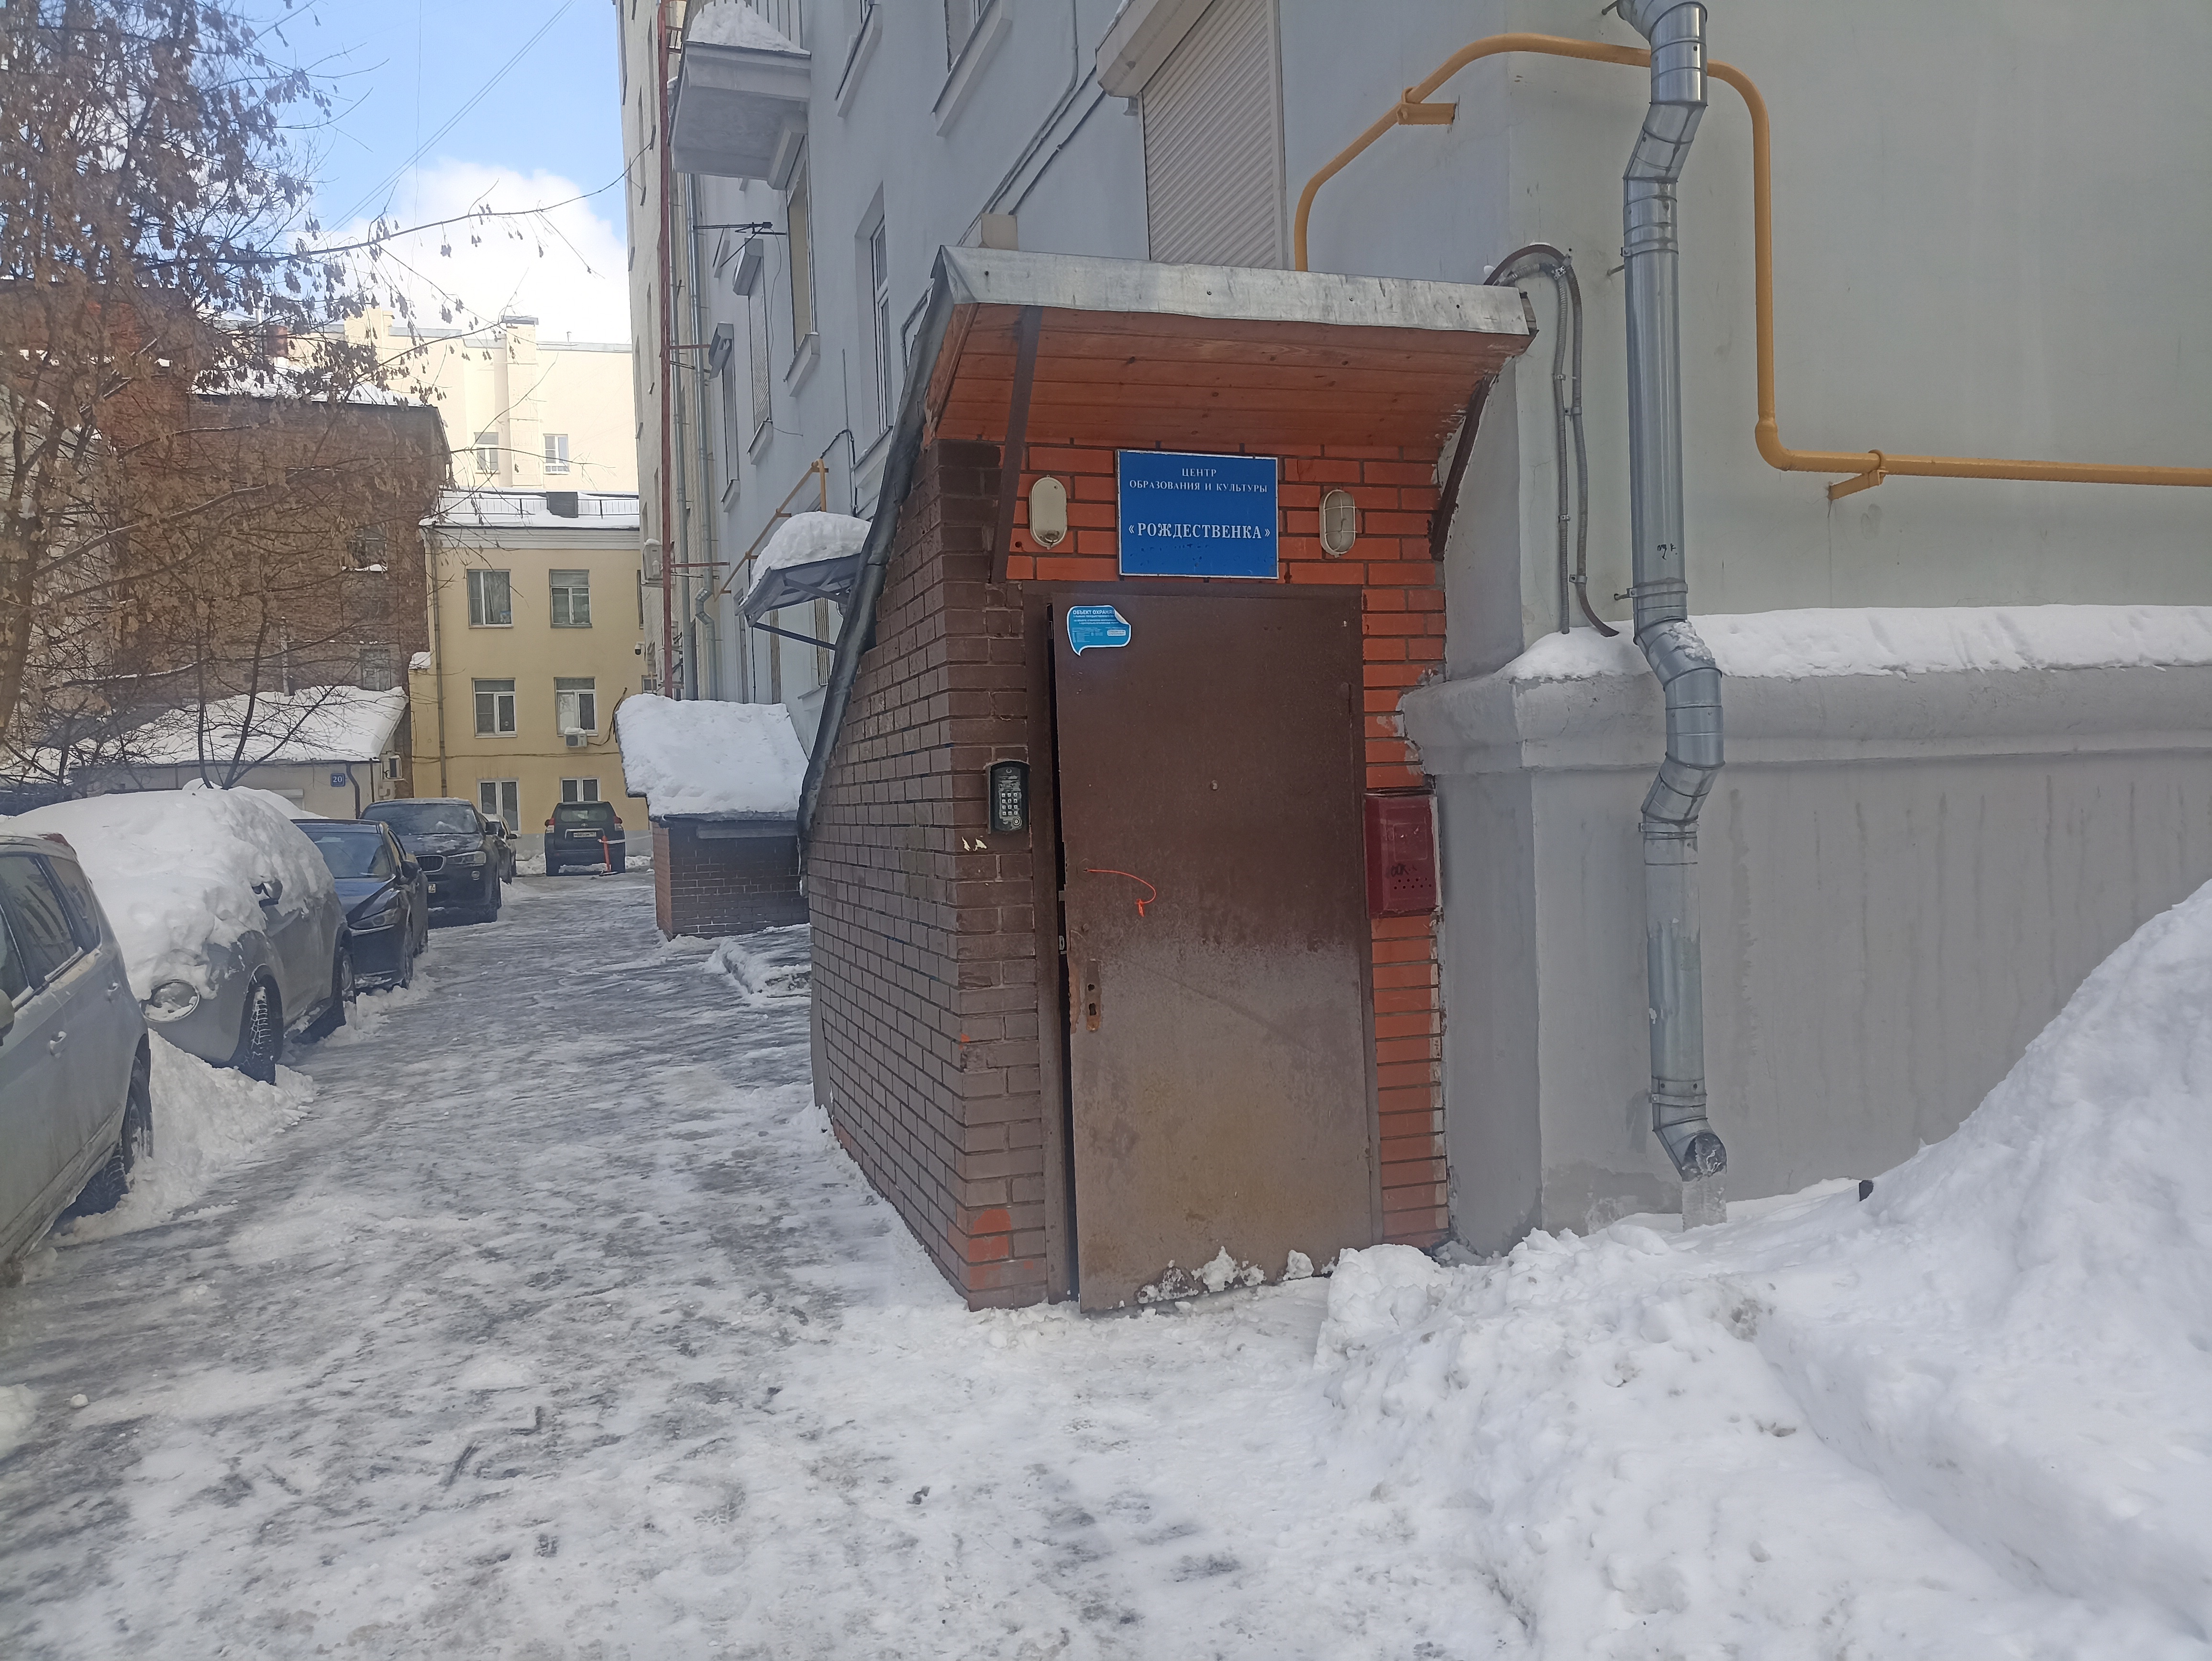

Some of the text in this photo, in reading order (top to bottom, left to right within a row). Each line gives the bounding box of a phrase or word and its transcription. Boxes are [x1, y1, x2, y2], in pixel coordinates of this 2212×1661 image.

[1182, 468, 1217, 477] ЦЕНТР
[1129, 480, 1268, 493] ОБРАЗОВАНИЯ И КУЛЬТУРЫ
[1128, 522, 1271, 539] «РОЖДЕСТВЕНКА»
